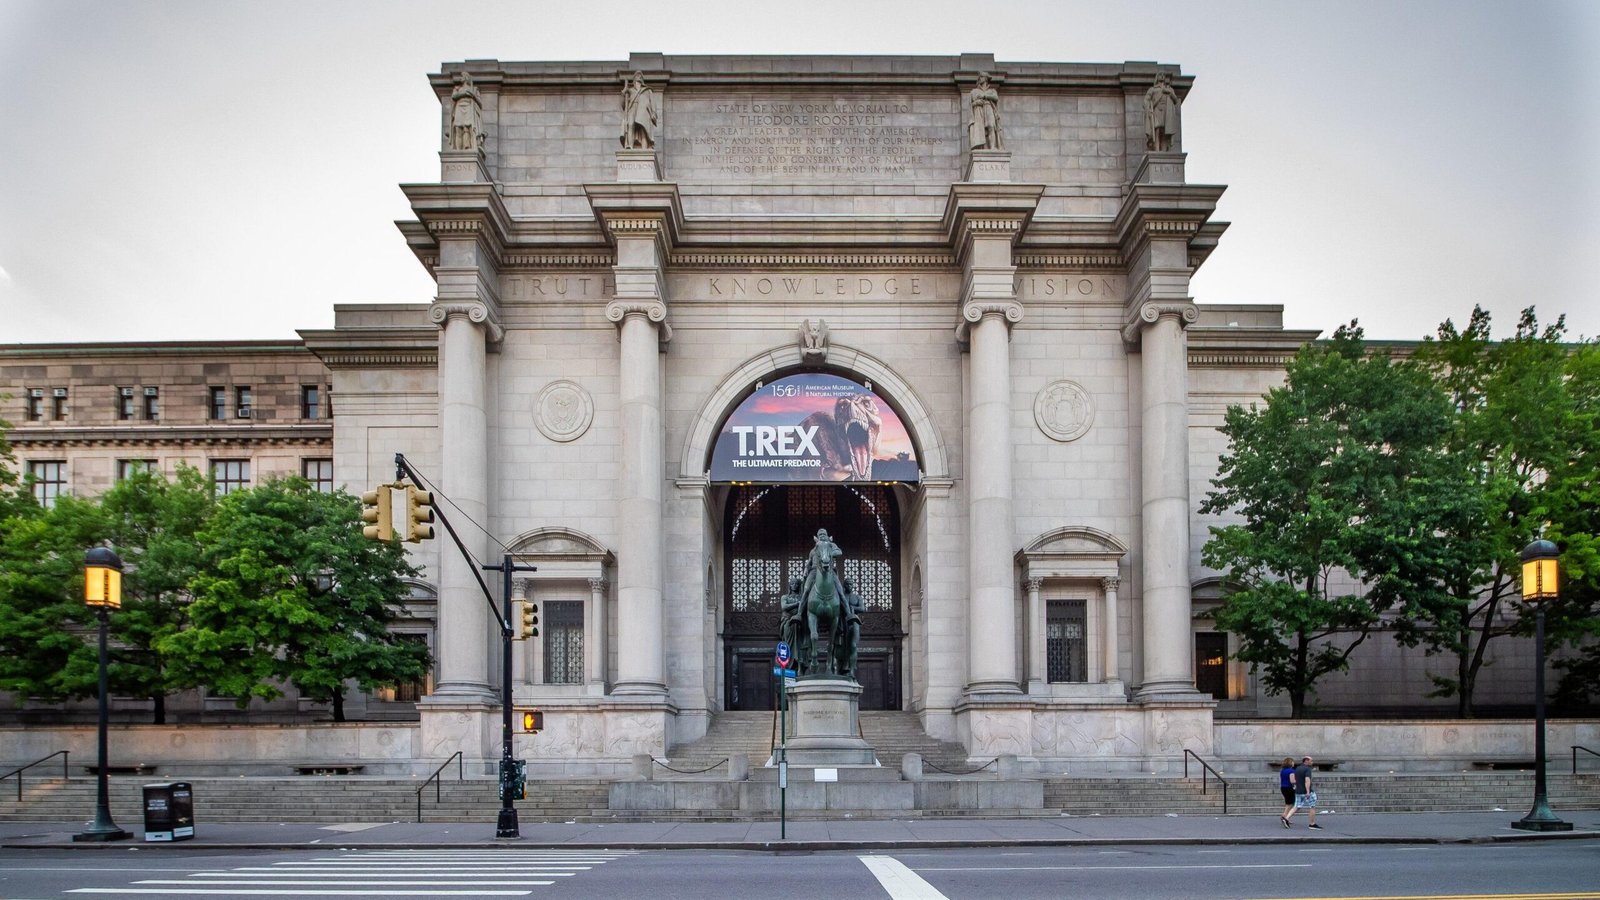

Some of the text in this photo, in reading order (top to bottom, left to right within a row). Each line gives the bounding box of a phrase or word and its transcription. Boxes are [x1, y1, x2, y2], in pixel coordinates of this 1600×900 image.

[716, 105, 908, 113] STATE OF NEW YORK MEMORIAL TO
[739, 116, 886, 125] THEODORE ROOSEVELT
[791, 156, 864, 164] CONSERVATION
[508, 278, 617, 295] TRUTH
[709, 278, 921, 295] KNOWLEDGE
[1012, 278, 1117, 295] VISION
[732, 426, 820, 456] T.REX
